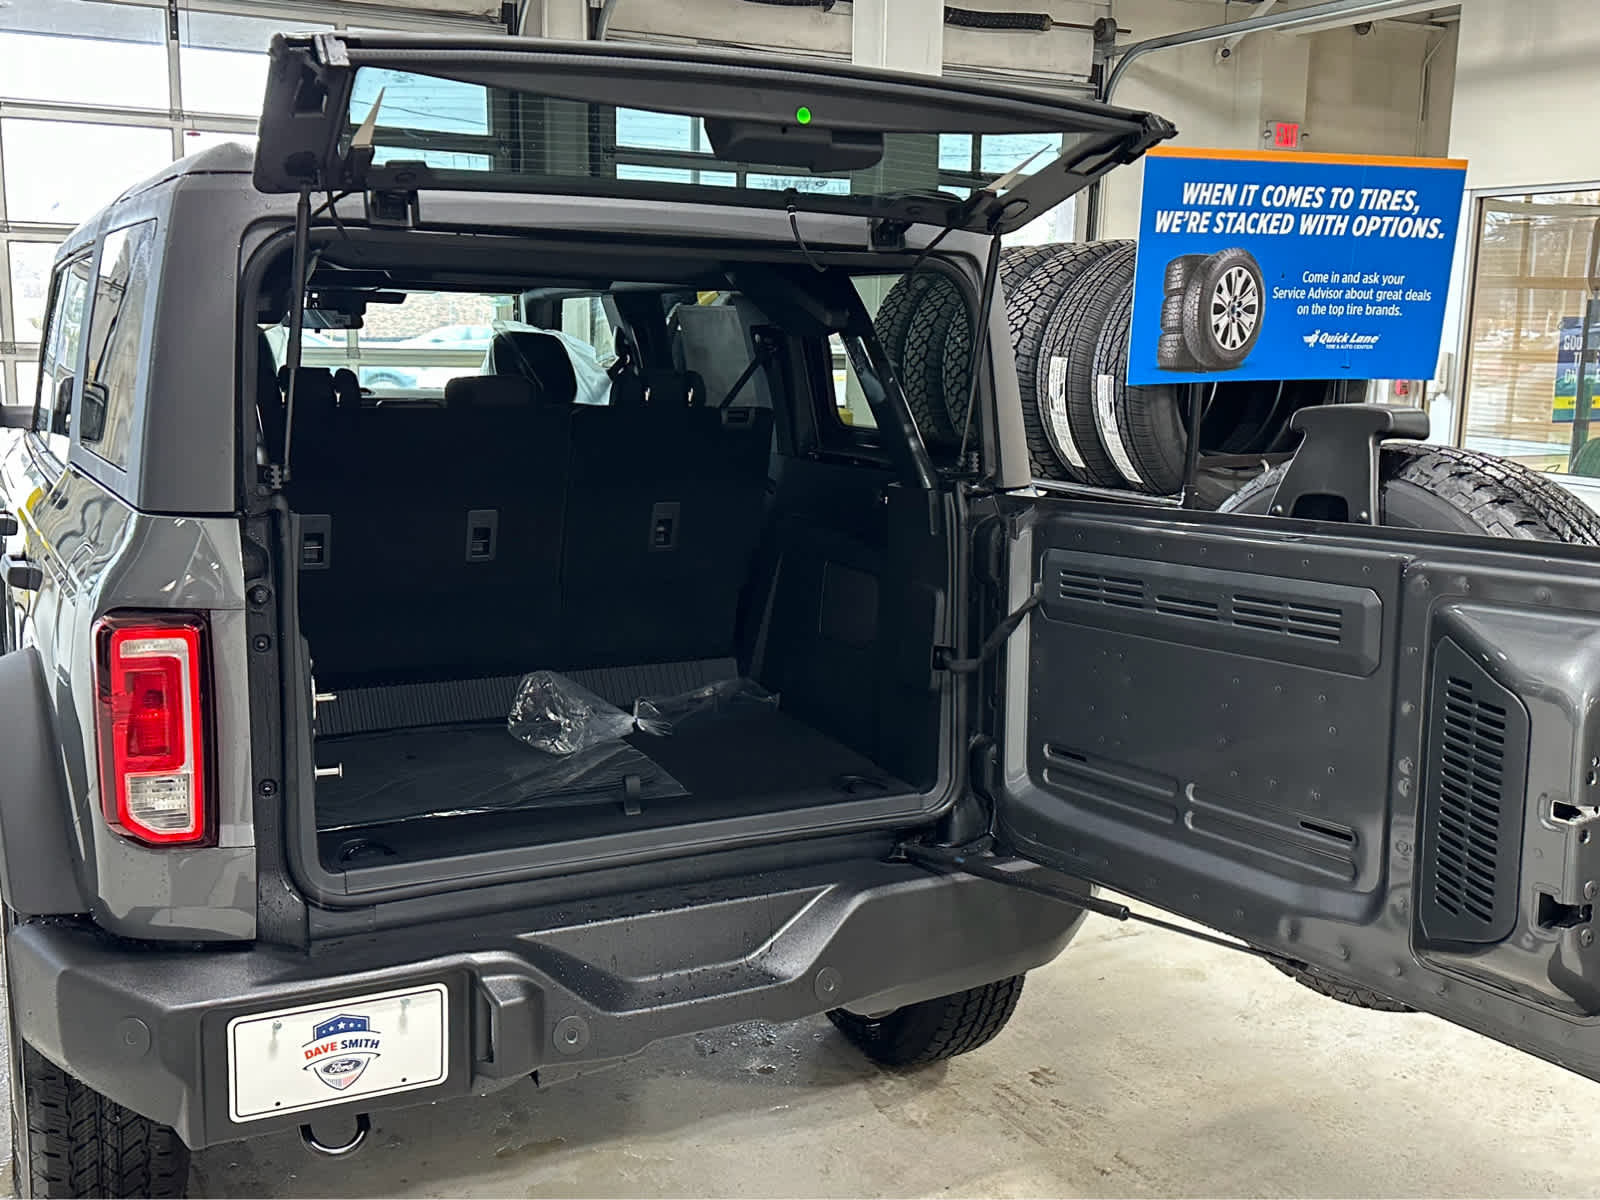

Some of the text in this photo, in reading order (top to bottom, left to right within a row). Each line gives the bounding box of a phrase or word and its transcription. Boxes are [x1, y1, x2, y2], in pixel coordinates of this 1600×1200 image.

[1275, 123, 1298, 147] EXIT
[1182, 182, 1420, 215] WHEN IT COMES TO TIRES,
[1155, 210, 1446, 239] WE'RE STACKED WITH OPTIONS.
[1302, 271, 1405, 287] Come in and ask your
[1272, 286, 1432, 302] Service Advisor about great deals
[1296, 303, 1403, 317] on the top tire brands.
[1319, 332, 1379, 344] Quick Lane
[304, 1039, 380, 1060] DAVE SMITH
[329, 1060, 356, 1073] Ford
